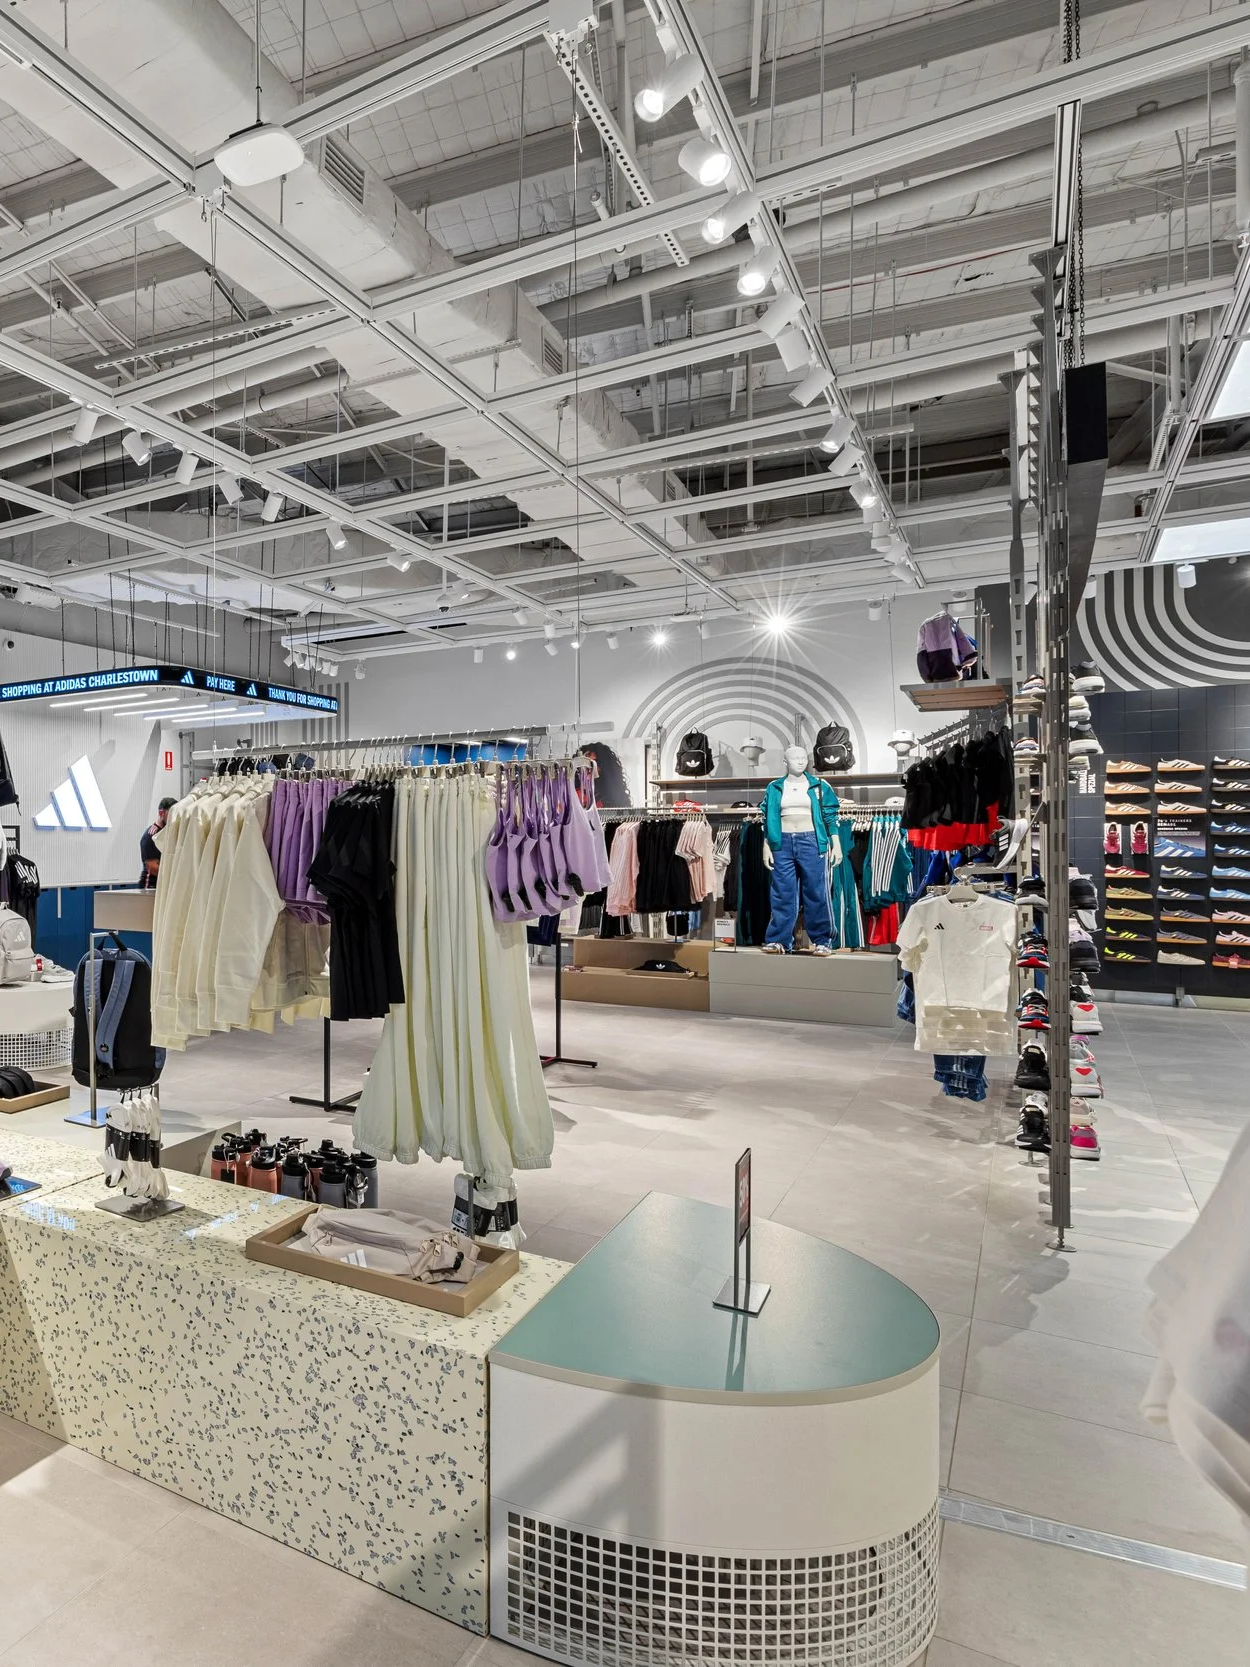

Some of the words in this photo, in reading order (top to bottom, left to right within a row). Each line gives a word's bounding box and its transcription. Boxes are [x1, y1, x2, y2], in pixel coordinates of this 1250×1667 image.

[2, 683, 42, 698] SHOPPING
[43, 682, 54, 693] AT
[55, 678, 87, 691] ADIDAS
[88, 670, 158, 687] CHARLESTOWN
[207, 676, 219, 689] PAY
[219, 678, 235, 692] HERE
[268, 687, 286, 701] THANK
[286, 691, 296, 703] YOU
[297, 693, 307, 705] FOR
[307, 695, 330, 709] SHOPPING
